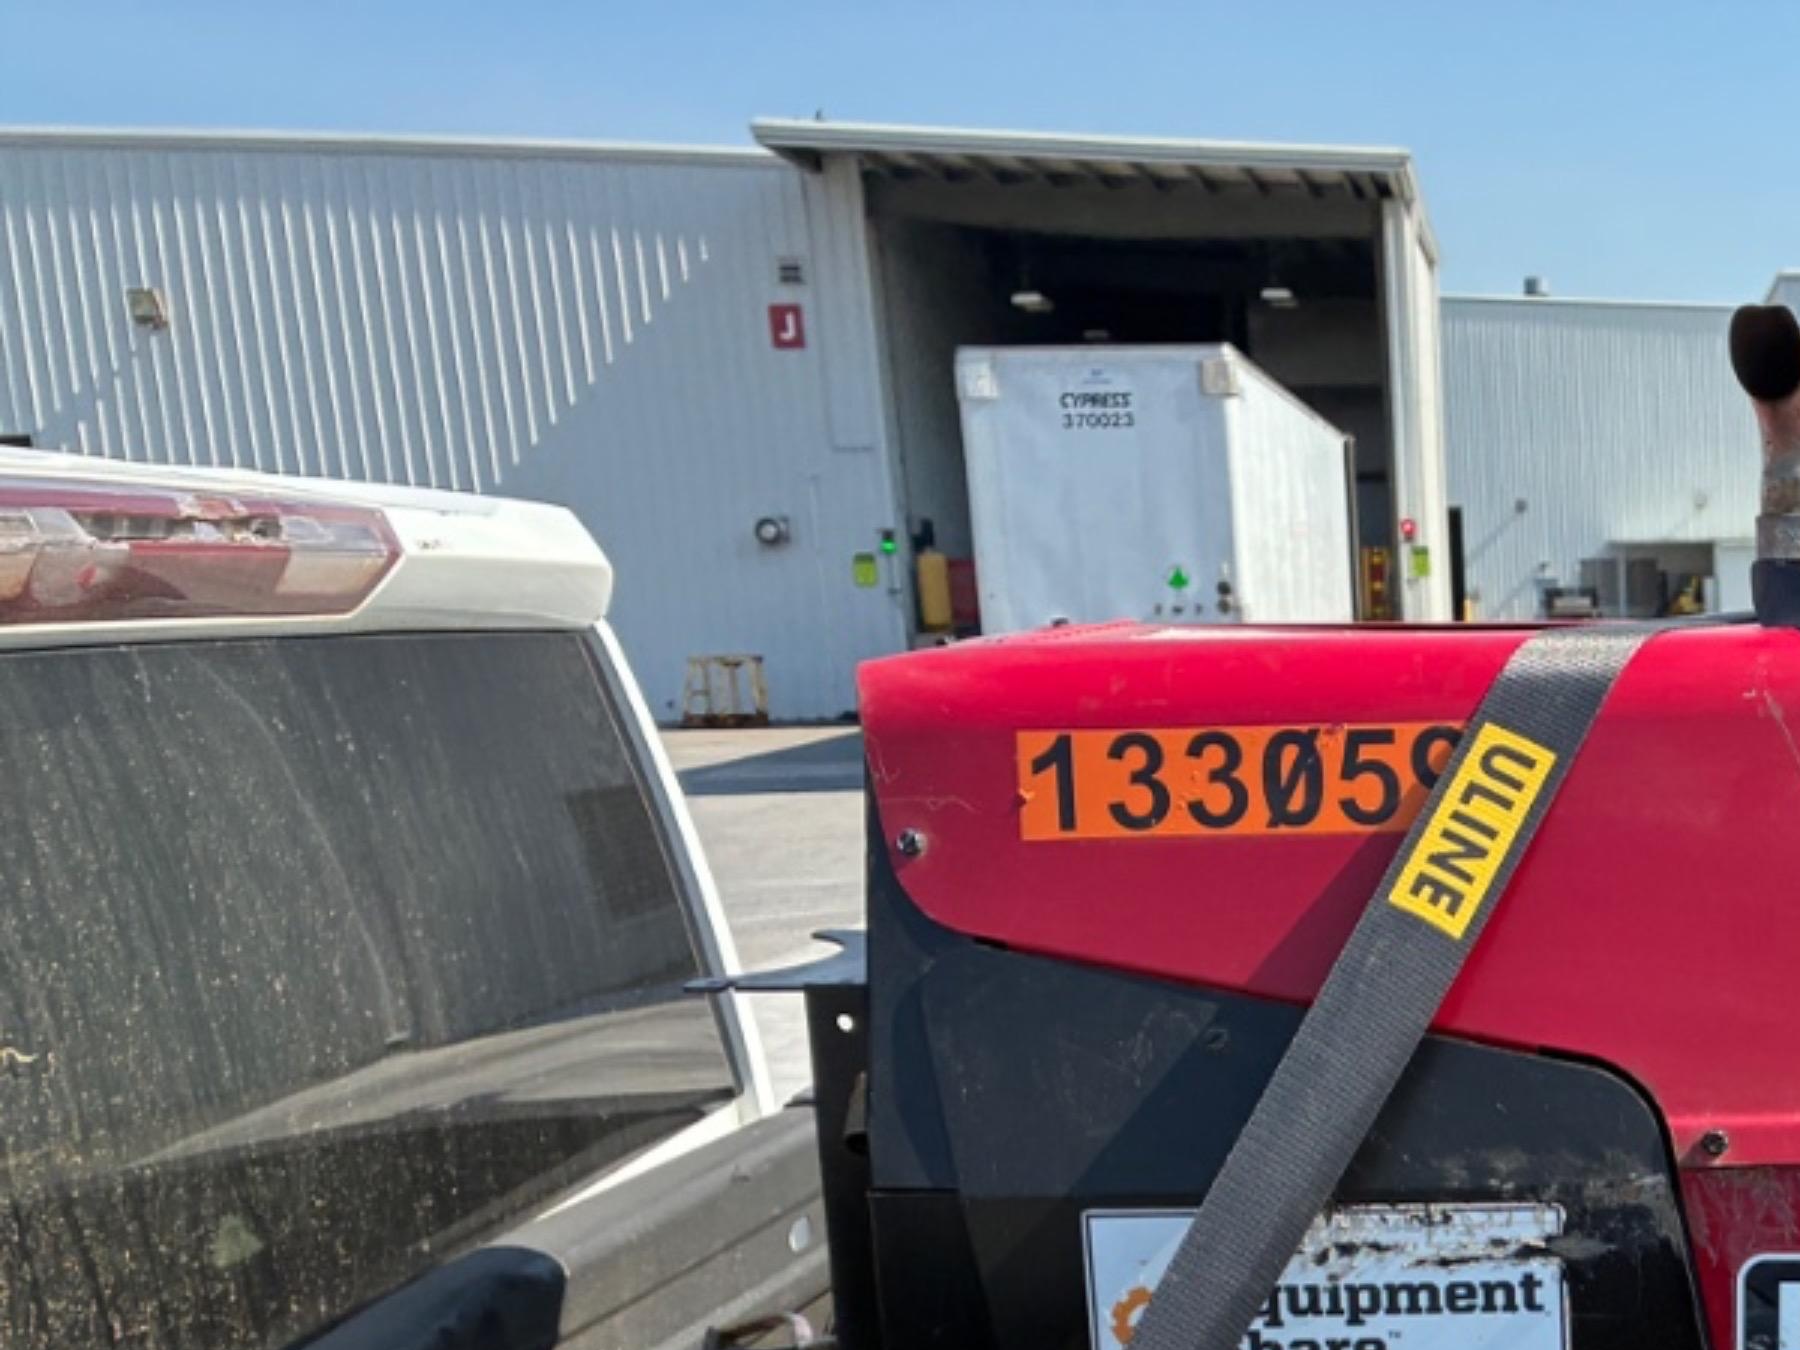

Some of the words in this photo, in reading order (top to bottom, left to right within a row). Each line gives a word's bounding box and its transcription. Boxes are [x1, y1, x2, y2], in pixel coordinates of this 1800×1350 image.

[779, 312, 797, 341] J
[1059, 391, 1132, 410] CYPRESS
[1408, 744, 1538, 917] ULINE
[1257, 1272, 1545, 1327] quipment
